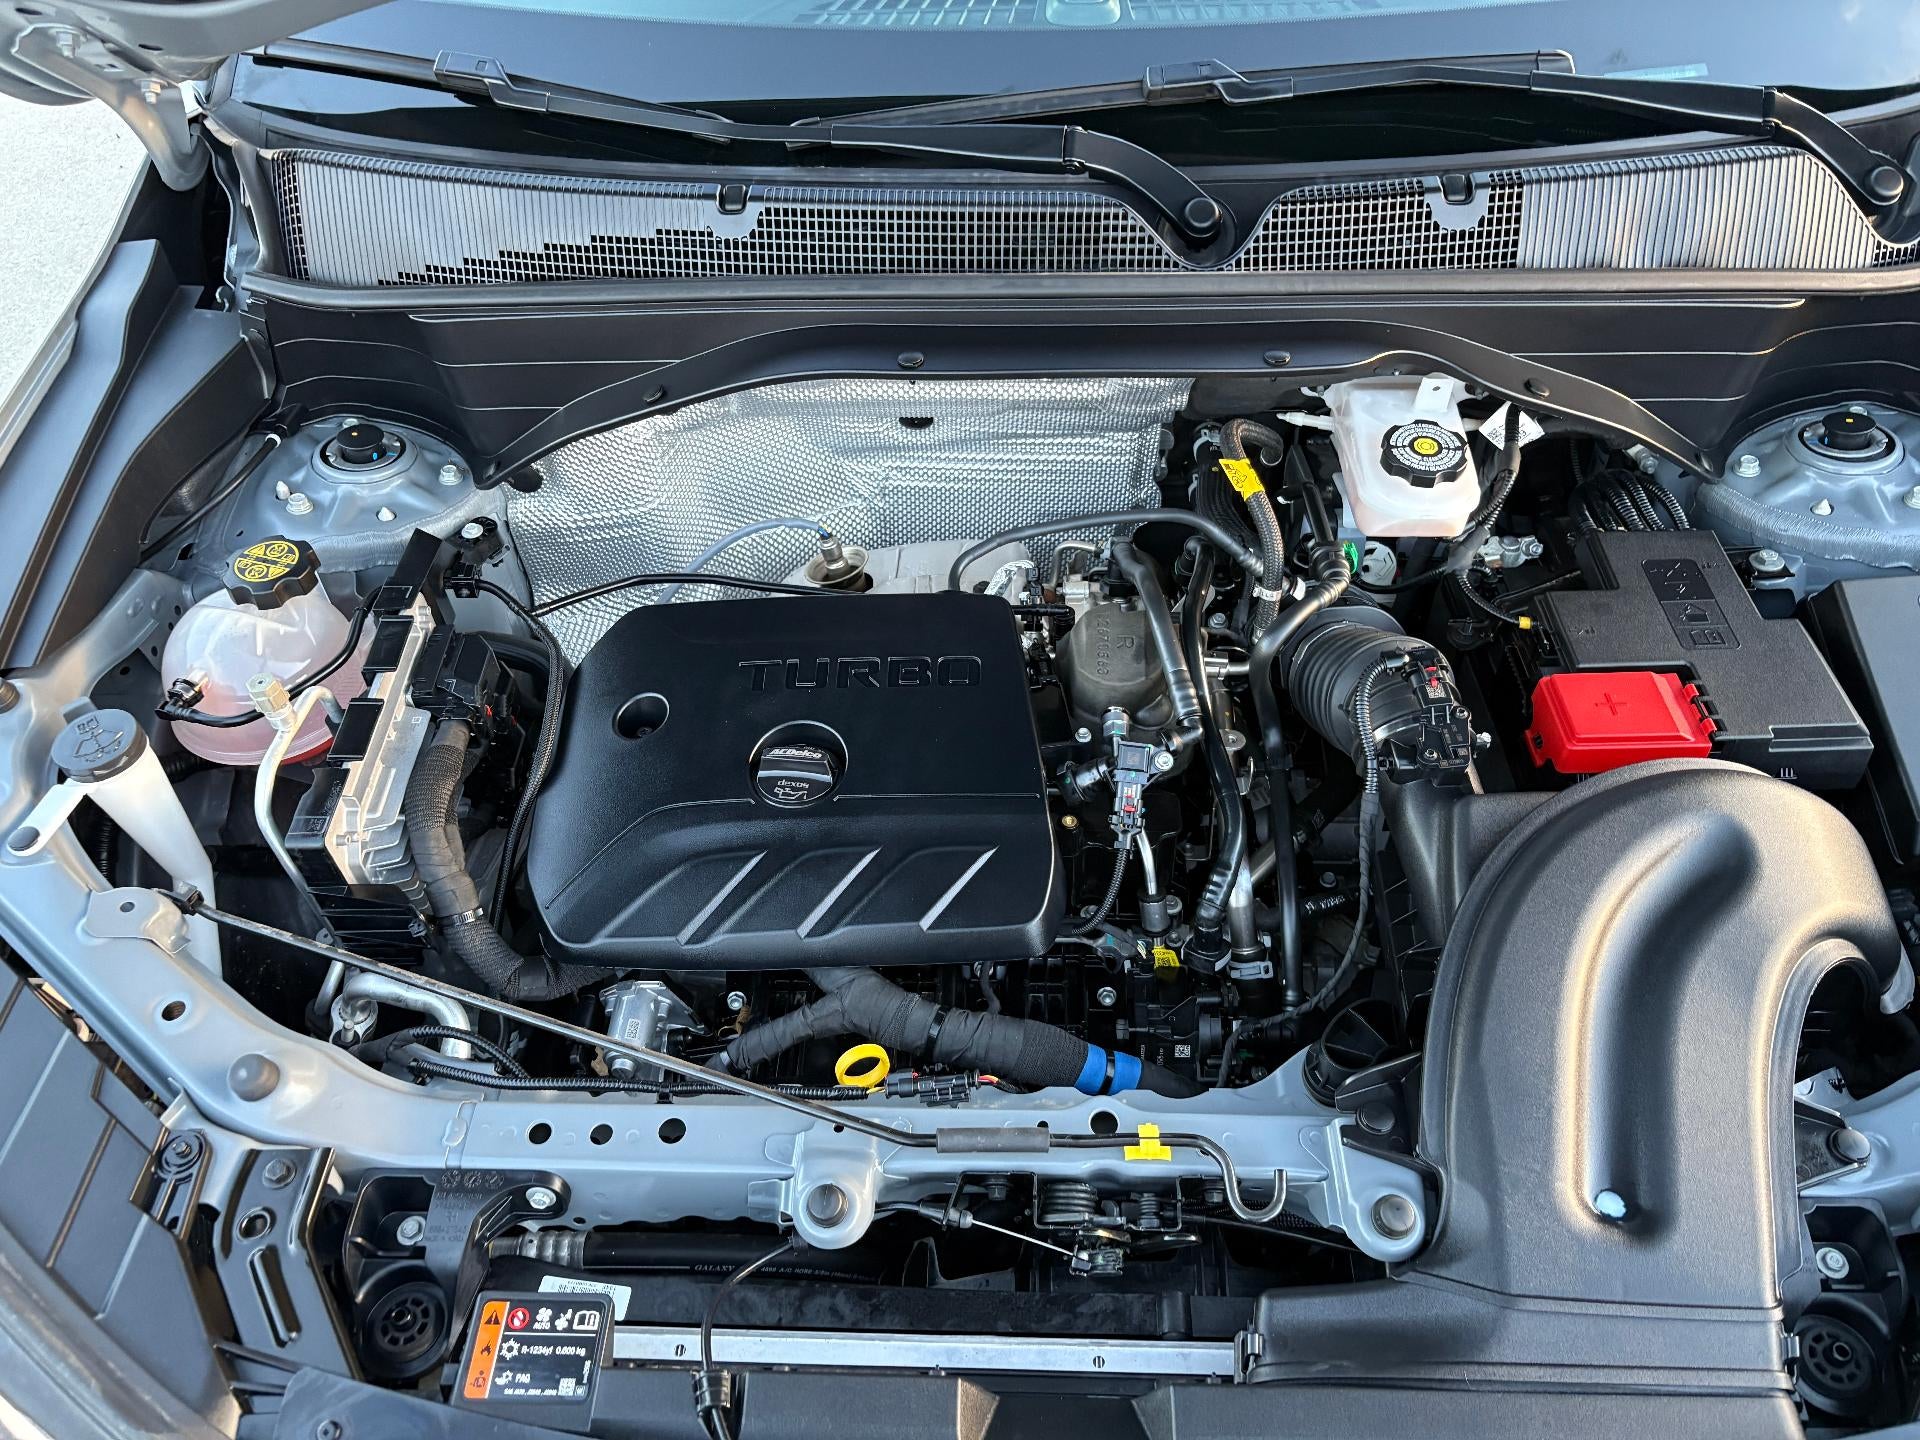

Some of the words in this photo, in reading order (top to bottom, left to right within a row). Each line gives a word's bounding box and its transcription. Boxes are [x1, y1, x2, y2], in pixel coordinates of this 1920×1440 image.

[1116, 634, 1136, 648] R
[738, 656, 982, 691] TURBO
[769, 748, 823, 759] ACDelco
[777, 779, 809, 789] dexos
[694, 1264, 736, 1272] GALAXY
[533, 1321, 551, 1330] AUTO
[521, 1345, 553, 1357] R-1234yf
[576, 1347, 586, 1357] kg
